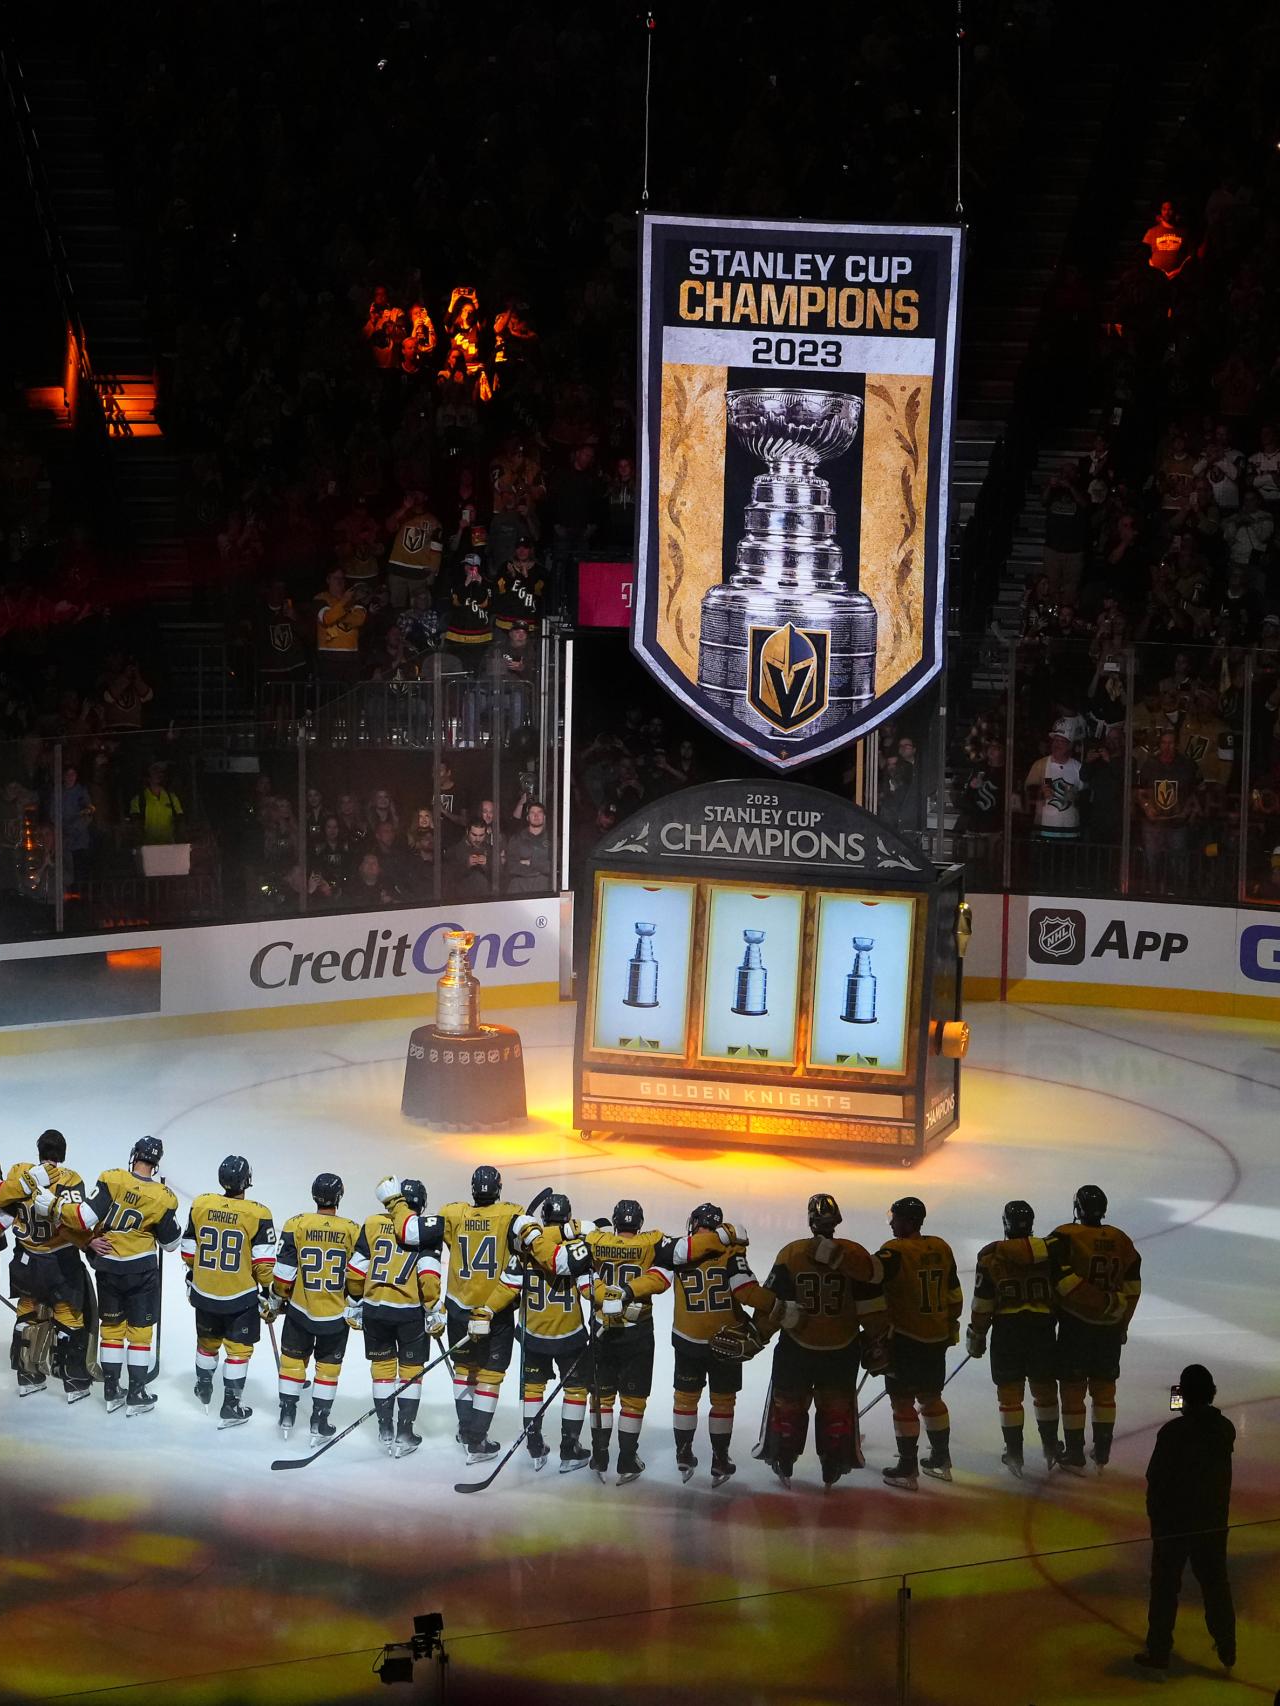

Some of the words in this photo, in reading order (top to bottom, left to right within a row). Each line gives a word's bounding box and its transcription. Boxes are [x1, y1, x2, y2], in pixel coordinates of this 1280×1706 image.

[688, 247, 836, 281] STANLEY
[845, 254, 913, 284] CUP
[677, 279, 920, 331] CHAMPIONS
[751, 336, 843, 368] 2023
[512, 580, 537, 613] EGAS
[746, 793, 780, 806] 2023
[704, 805, 783, 825] STANLEY
[786, 811, 822, 828] CUP
[660, 822, 866, 862] CHAMPIONS
[1047, 924, 1070, 947] NHL
[639, 1081, 730, 1100] GOLDEN
[744, 1090, 852, 1110] KNIGHTS
[60, 1190, 83, 1204] 36
[123, 1191, 142, 1206] ROY
[13, 1203, 53, 1243] 36
[103, 1202, 144, 1233] 10
[207, 1209, 239, 1225] CARRIER
[380, 1223, 395, 1235] THE
[464, 1219, 490, 1232] HAGUE
[199, 1226, 245, 1273] 28
[305, 1230, 346, 1245] MARTINEZ
[595, 1245, 643, 1260] BARBASHEV
[300, 1246, 348, 1292] 23
[370, 1238, 419, 1285] 27
[458, 1235, 498, 1279] 14
[523, 1267, 576, 1313] 94
[679, 1266, 733, 1312] 22
[795, 1271, 847, 1317] 33
[917, 1268, 945, 1315] 17
